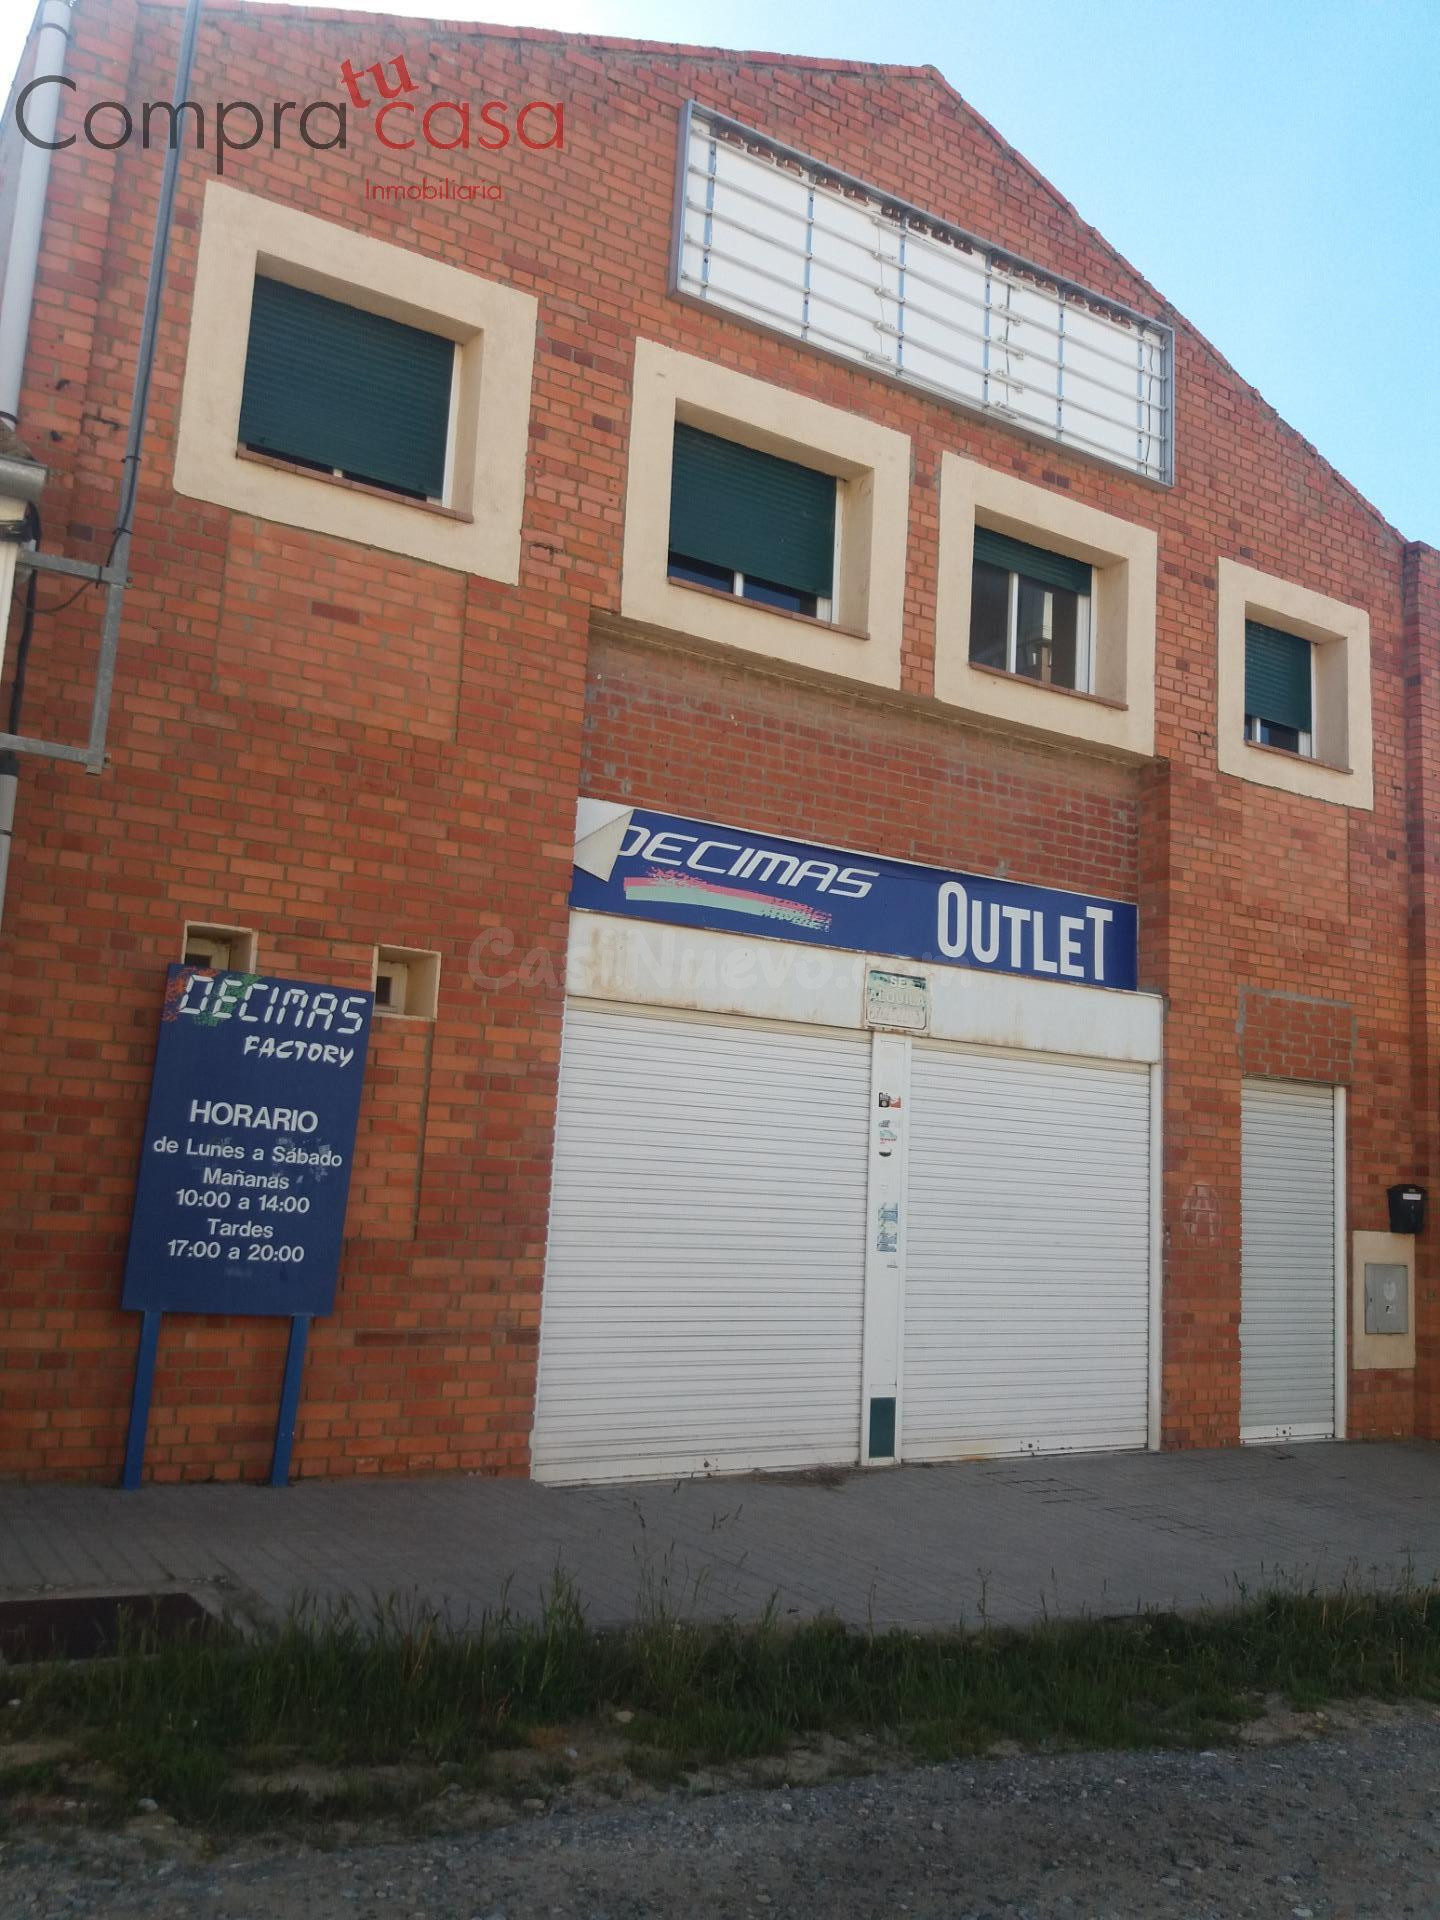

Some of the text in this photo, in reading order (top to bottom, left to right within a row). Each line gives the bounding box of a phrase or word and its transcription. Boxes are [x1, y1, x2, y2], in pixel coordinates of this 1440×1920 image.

[937, 881, 1113, 981] OUTLET
[178, 974, 367, 1035] DECIMAS
[243, 1035, 354, 1068] FACTORY
[189, 1099, 318, 1133] HORARIO
[153, 1136, 343, 1167] de Lunes a Sábado
[203, 1167, 290, 1190] Mañanas
[176, 1189, 310, 1214] 10:00 a 14:00
[207, 1218, 274, 1239] Tardes
[167, 1239, 305, 1263] 17:00 a 20:00
